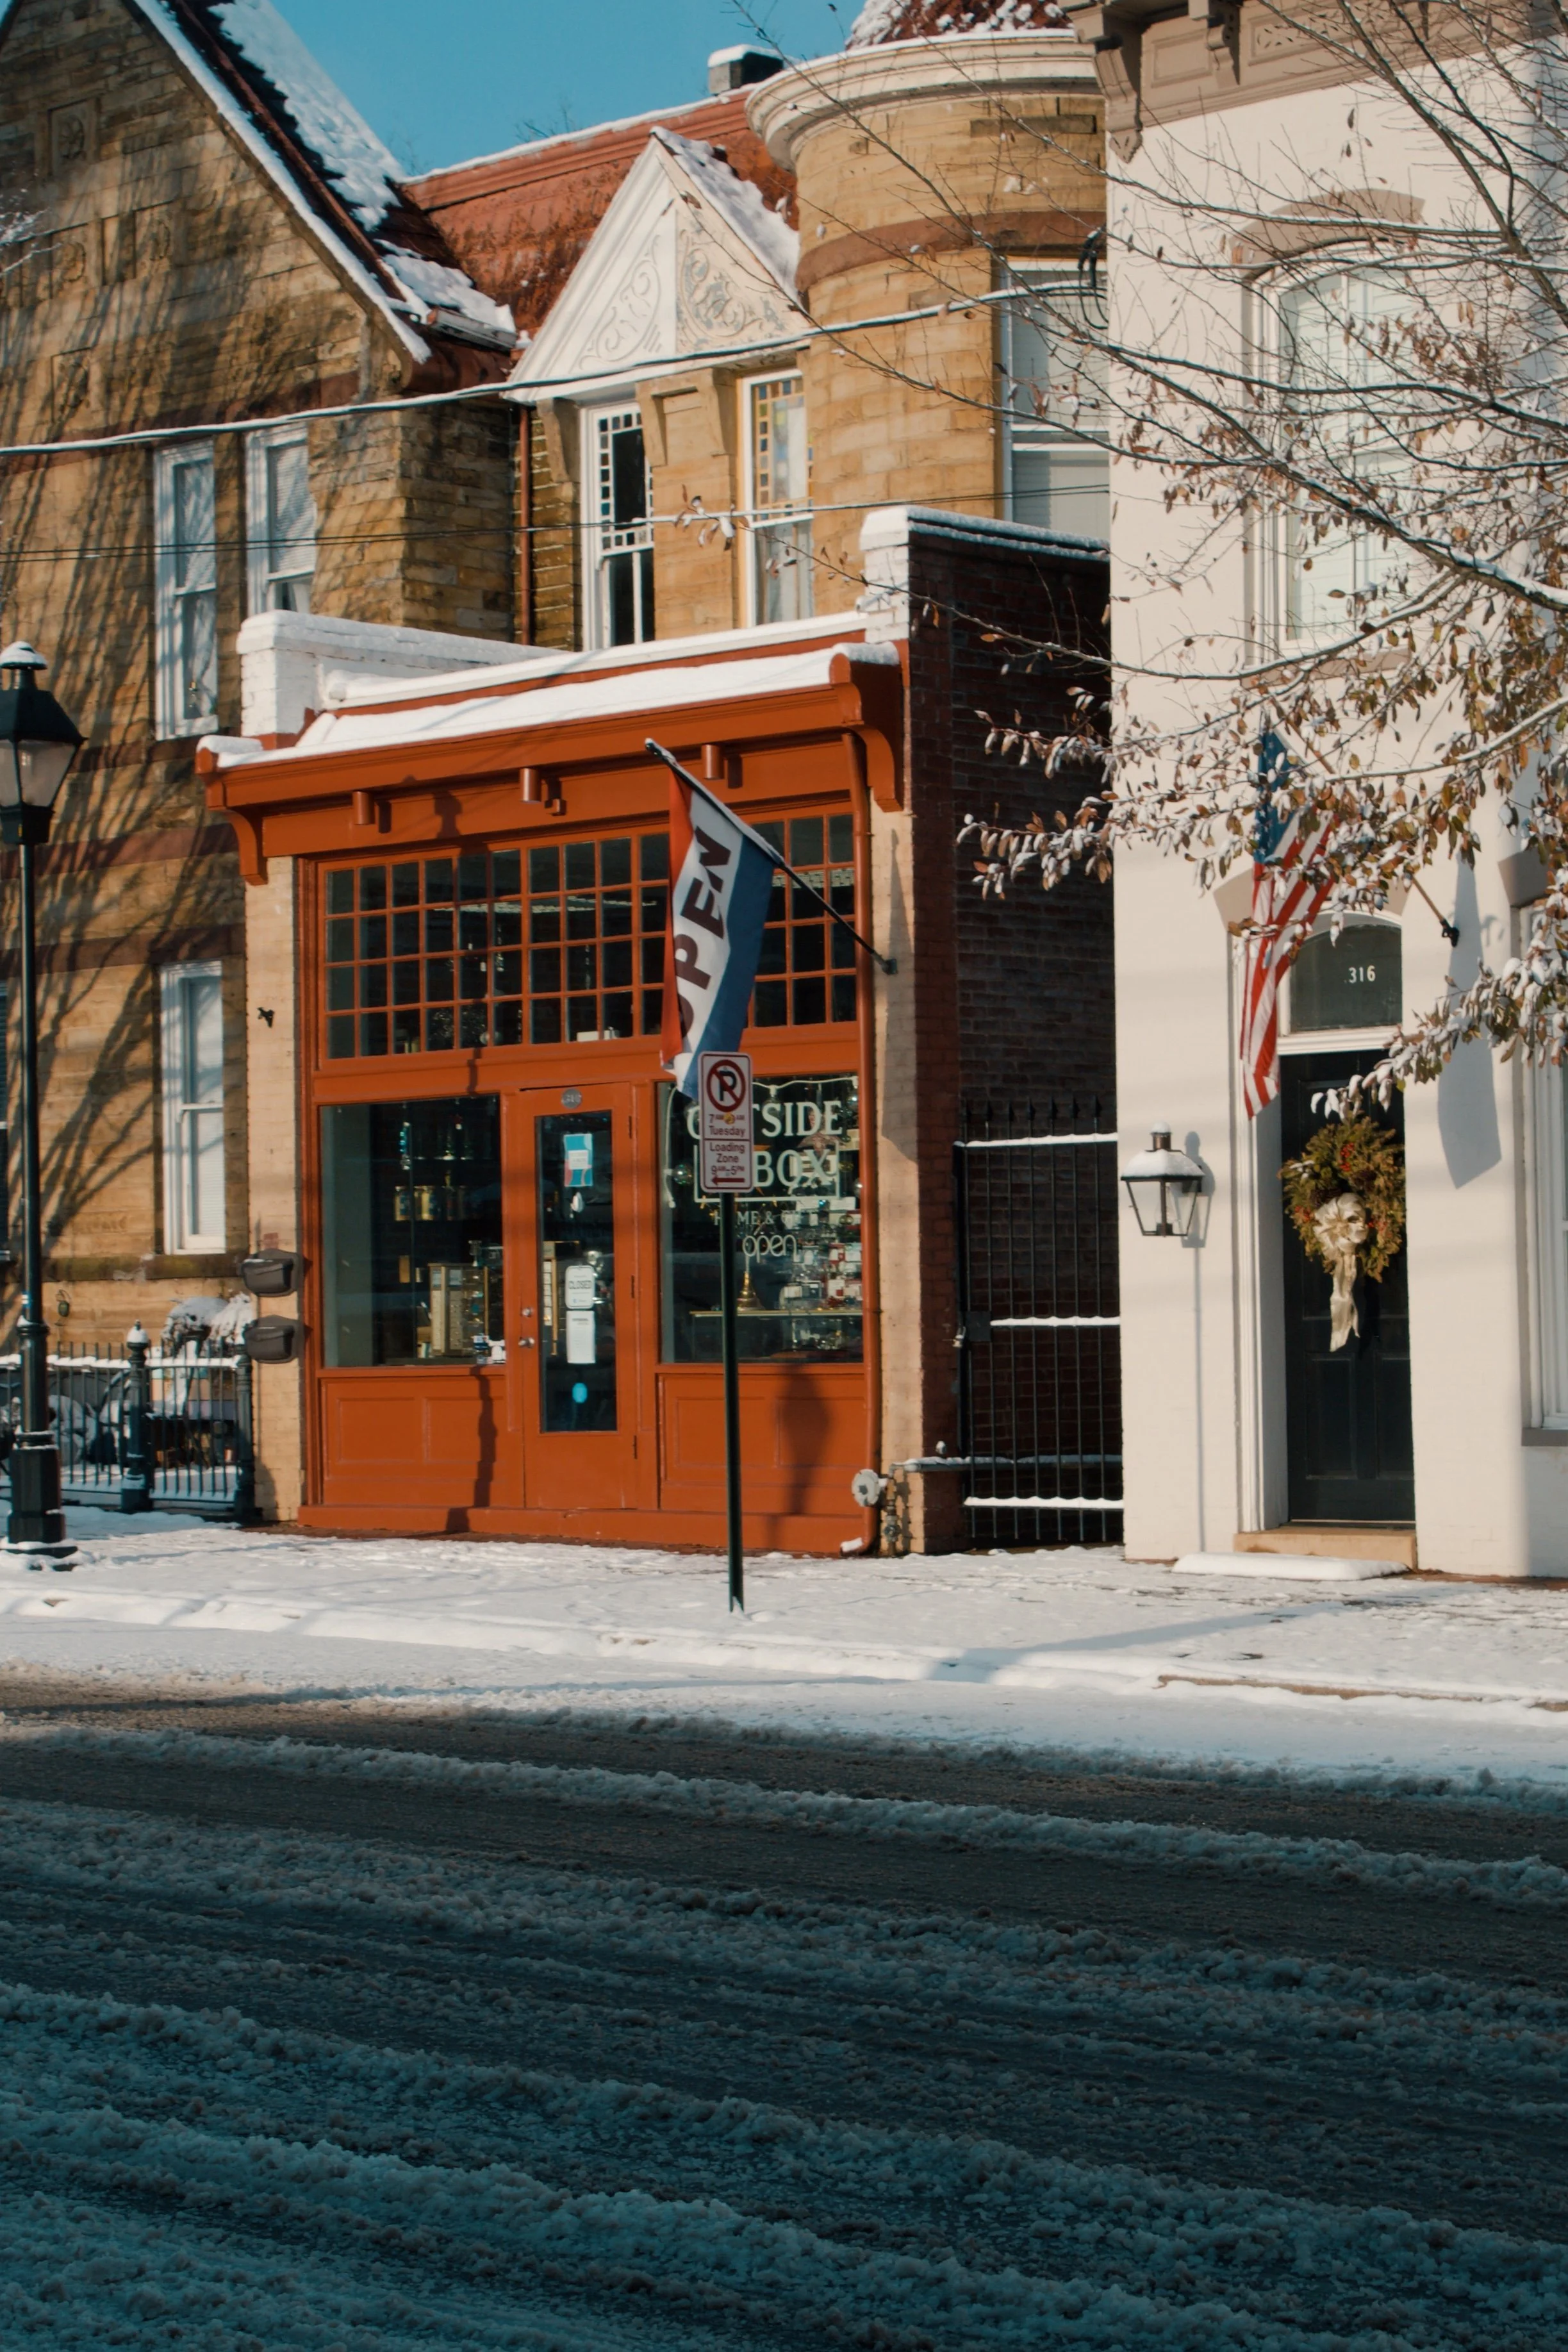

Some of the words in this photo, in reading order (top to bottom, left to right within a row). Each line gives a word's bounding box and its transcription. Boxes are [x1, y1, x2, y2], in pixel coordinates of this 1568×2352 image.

[1348, 965, 1376, 984] 316
[709, 1125, 745, 1138] Tuesday
[710, 1142, 745, 1154] Loading
[716, 1153, 739, 1163] Zone
[765, 1211, 774, 1225] &
[742, 1234, 798, 1264] open
